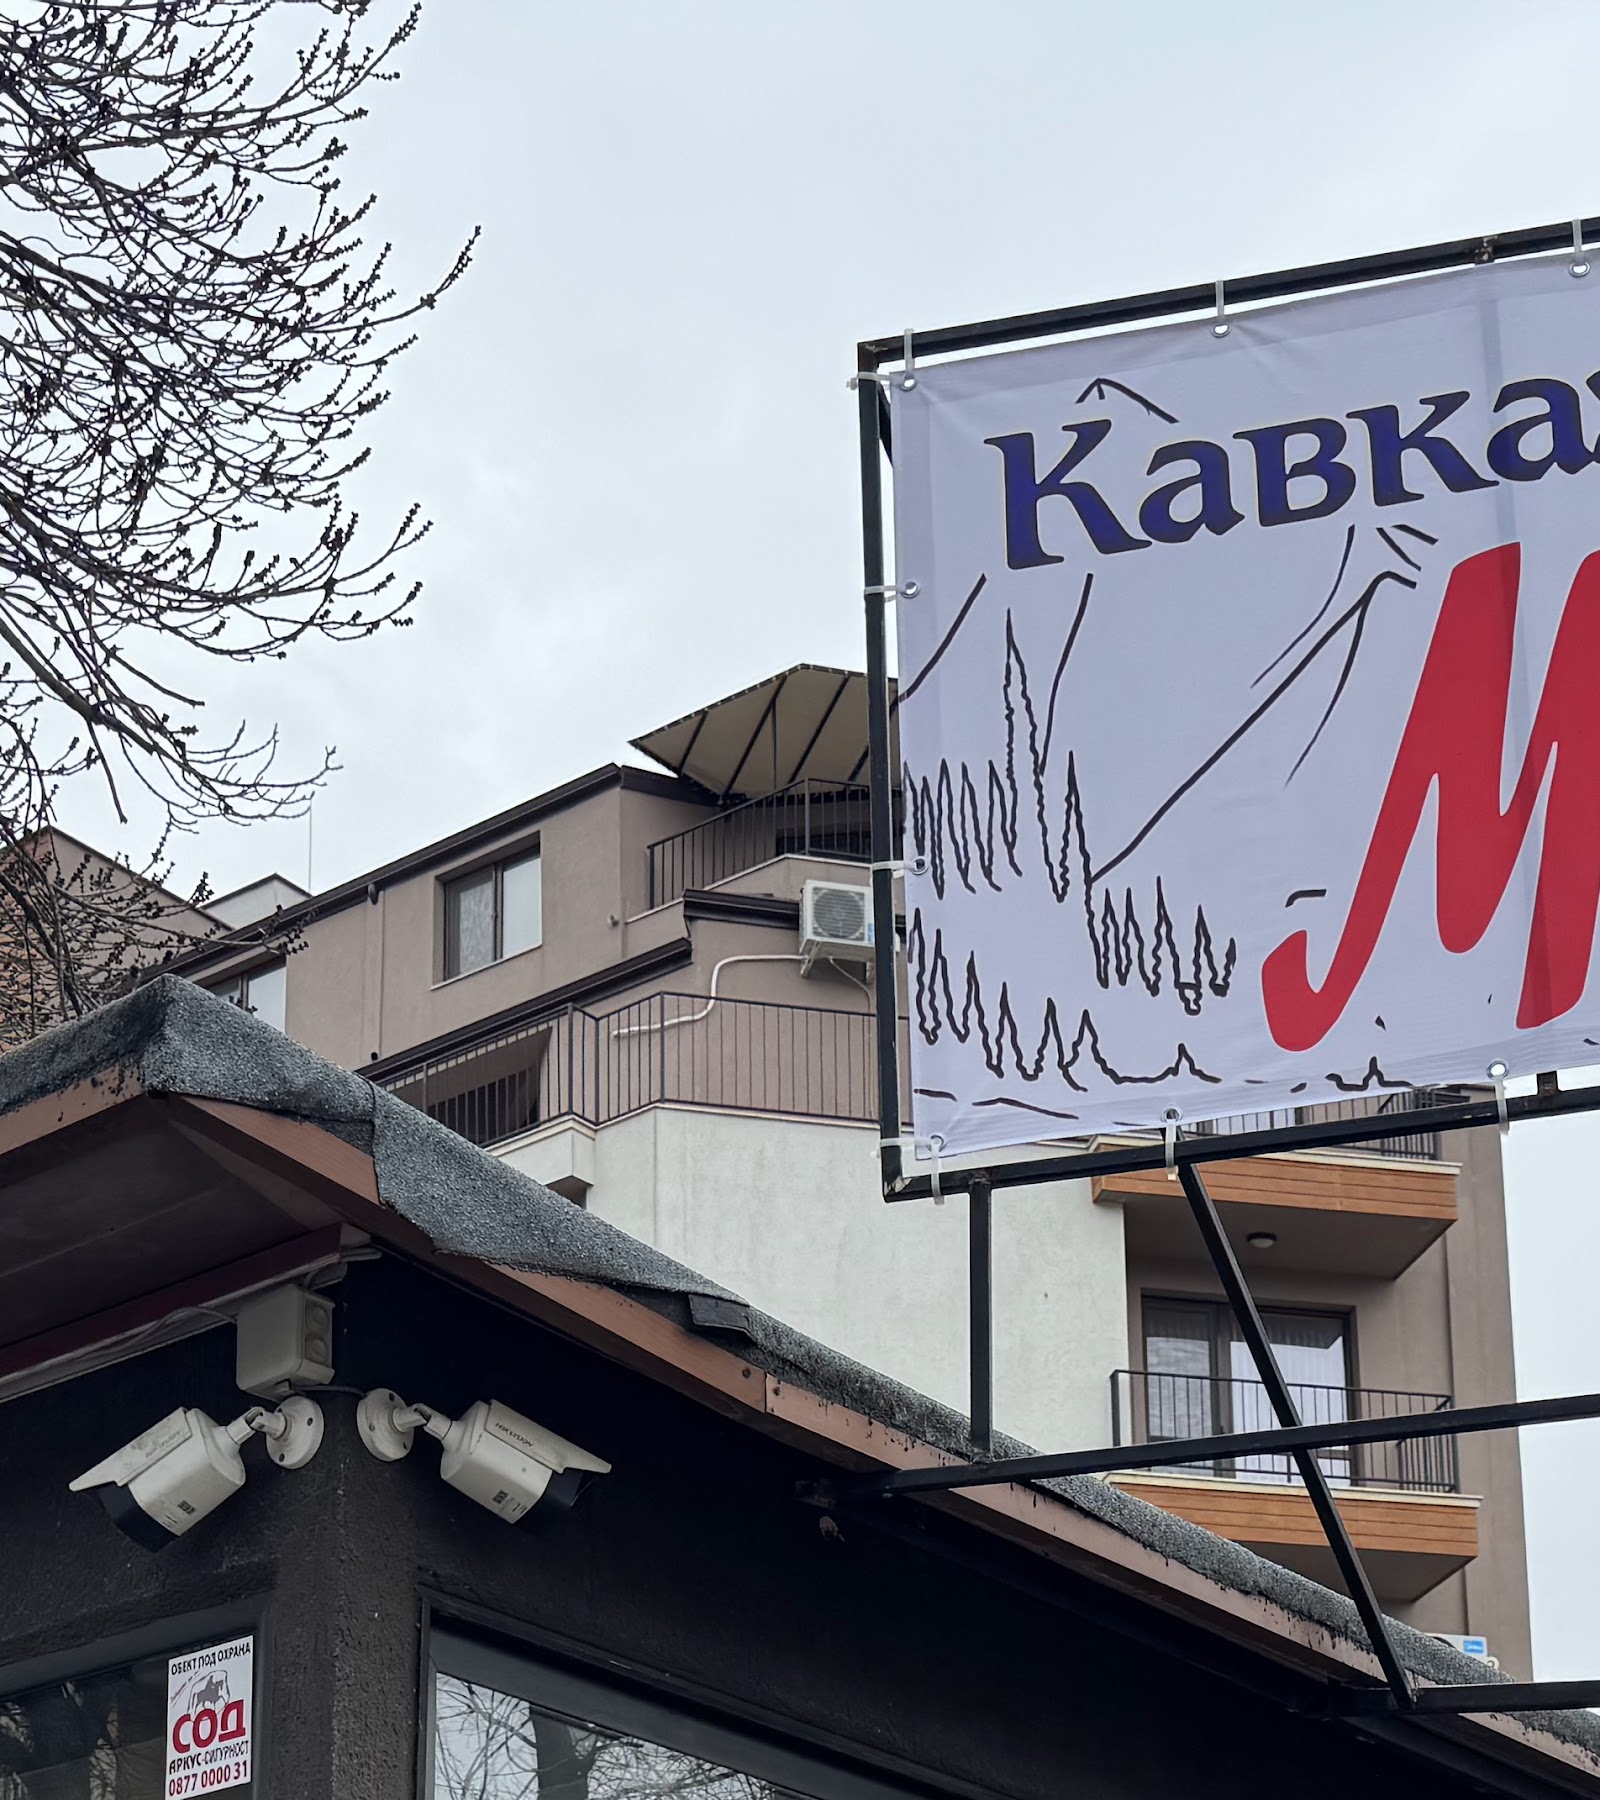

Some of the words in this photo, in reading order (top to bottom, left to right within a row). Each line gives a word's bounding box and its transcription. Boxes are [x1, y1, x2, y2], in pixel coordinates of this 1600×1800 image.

[171, 1657, 197, 1676] ОБЕКТ
[199, 1653, 217, 1669] ПОД
[218, 1642, 250, 1663] ОХРАНА
[172, 1699, 246, 1754] СОД
[169, 1740, 249, 1775] АРКУС-СИГУРНОСТ
[169, 1774, 198, 1797] 0877
[201, 1764, 231, 1788] 0000
[234, 1760, 248, 1781] 31
